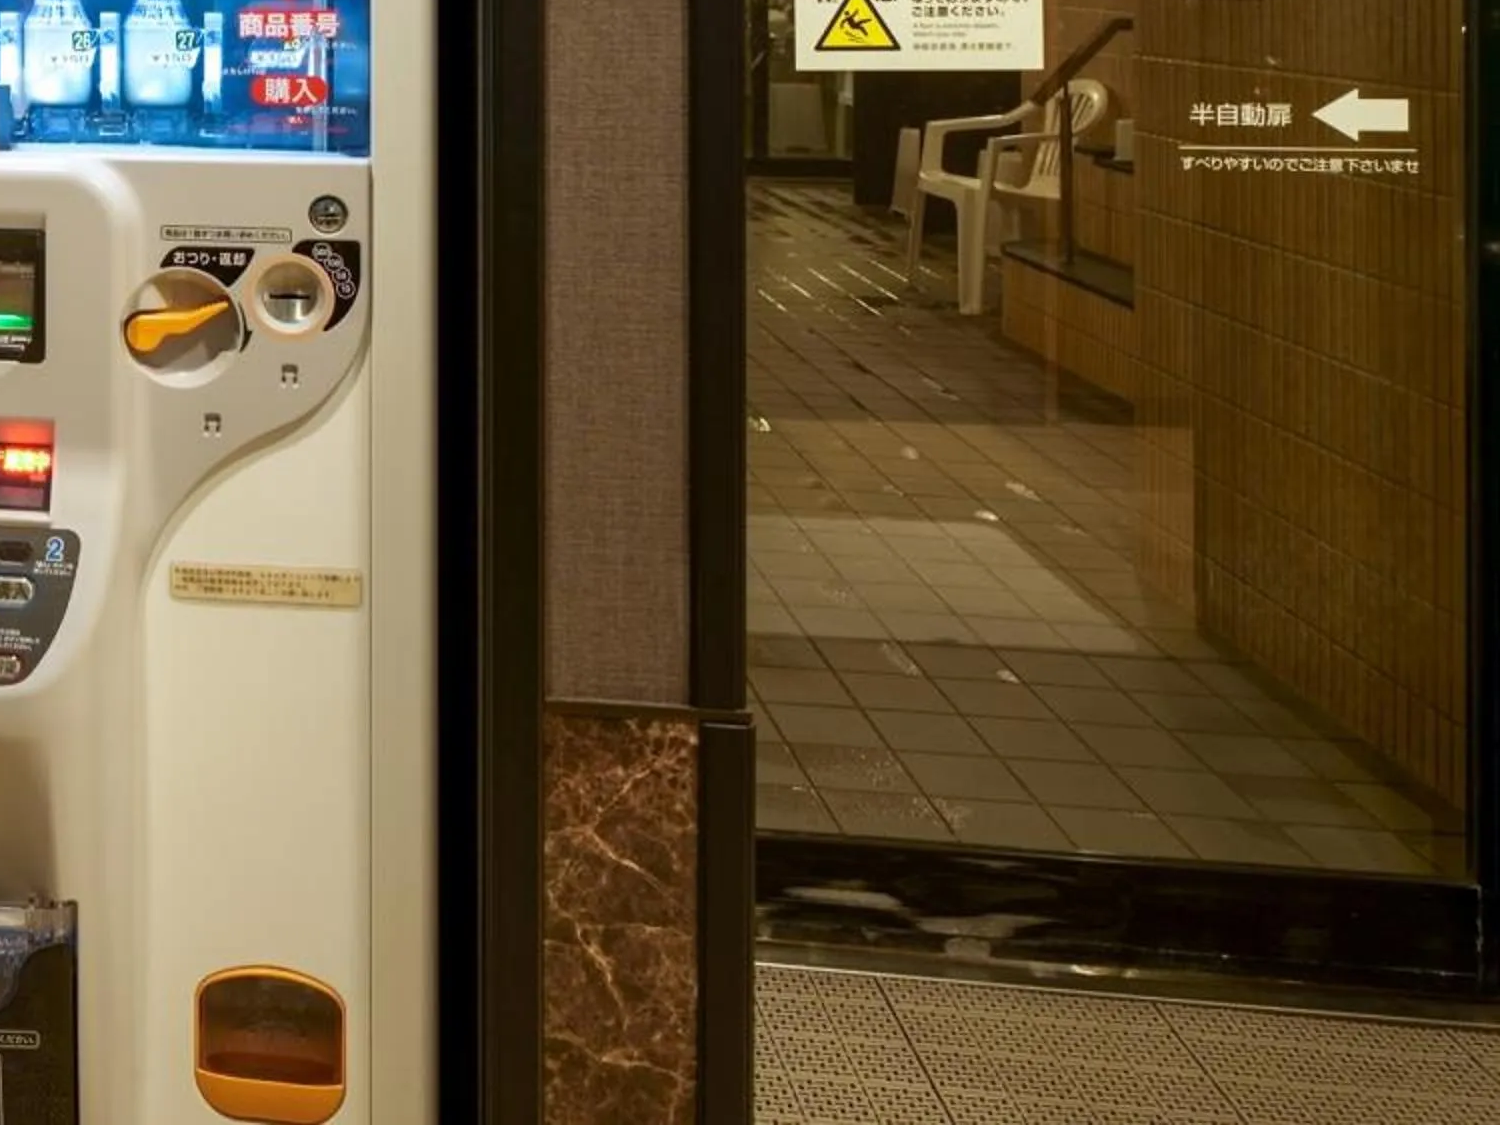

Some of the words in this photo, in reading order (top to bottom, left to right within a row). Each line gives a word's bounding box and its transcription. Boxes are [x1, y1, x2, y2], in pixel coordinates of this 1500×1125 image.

[238, 12, 341, 38] 商品番号
[264, 78, 318, 104] 購入
[1189, 102, 1293, 127] 半自動扉
[1180, 156, 1420, 174] すべりやすいのでご注意下さいませ
[46, 536, 65, 562] 2
